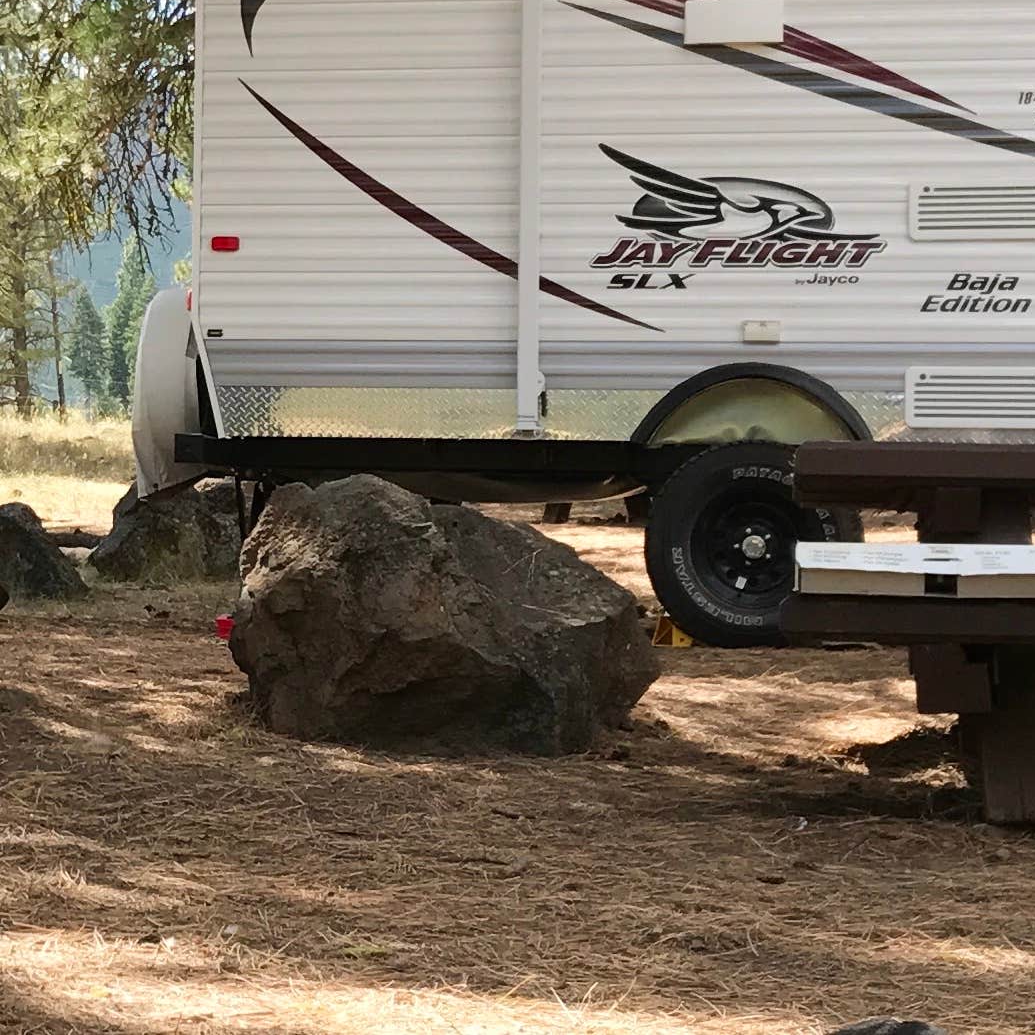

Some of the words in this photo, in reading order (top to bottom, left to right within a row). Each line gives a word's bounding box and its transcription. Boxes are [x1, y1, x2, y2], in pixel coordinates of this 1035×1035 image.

[589, 237, 702, 268] JAY
[688, 237, 887, 268] FLIGHT
[606, 273, 696, 290] SLX
[806, 272, 860, 286] Jayco
[946, 273, 1019, 295] Baja
[920, 295, 1032, 313] Edition
